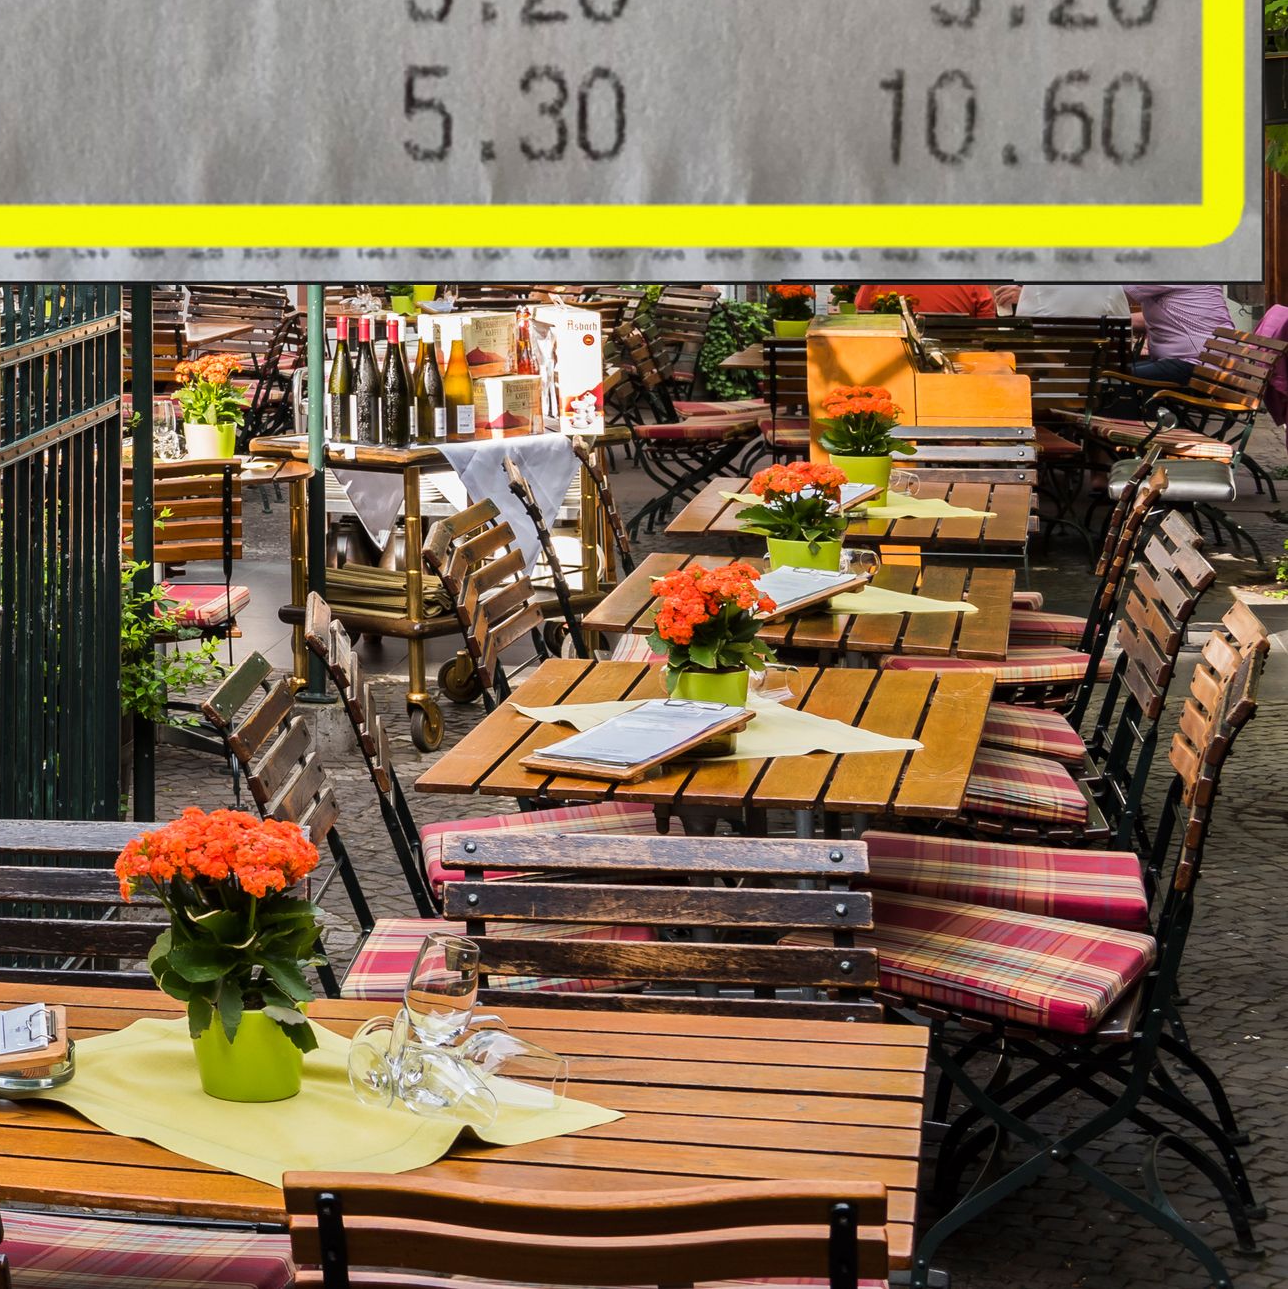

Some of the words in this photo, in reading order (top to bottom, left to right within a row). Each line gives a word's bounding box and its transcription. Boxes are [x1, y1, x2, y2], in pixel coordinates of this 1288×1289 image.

[404, 66, 626, 162] 5.30
[881, 70, 1153, 166] 10.60
[567, 319, 598, 331] Asbach
